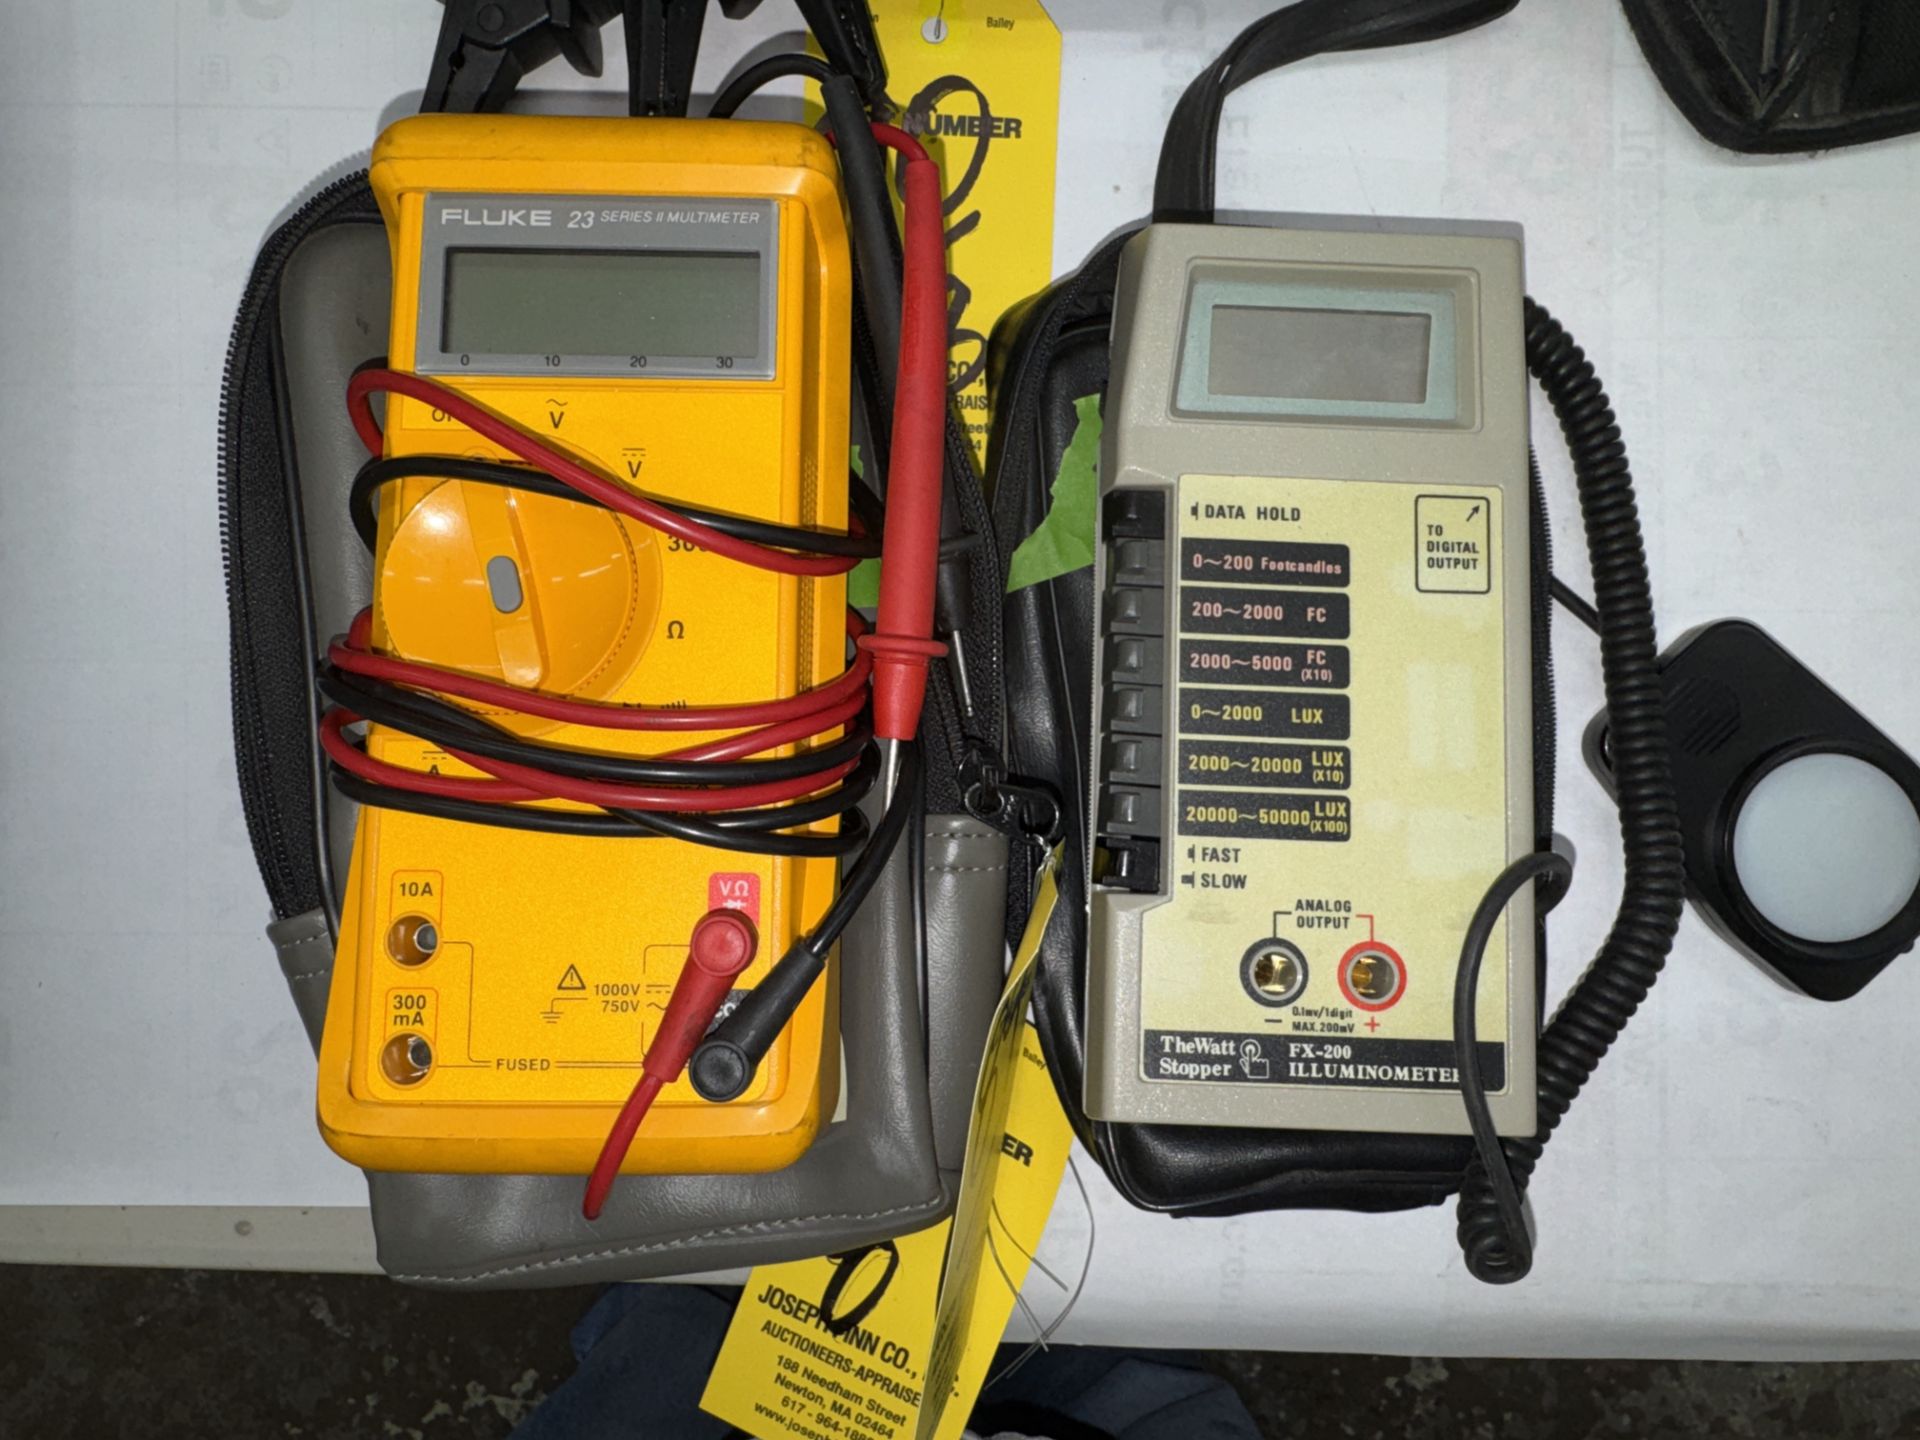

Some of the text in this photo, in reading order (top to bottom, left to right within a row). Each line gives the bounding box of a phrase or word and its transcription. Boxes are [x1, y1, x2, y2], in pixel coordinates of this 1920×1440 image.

[986, 16, 1015, 31] Bailey
[441, 208, 552, 227] FLUKE
[567, 211, 595, 229] 23
[600, 210, 652, 224] SERIES
[666, 211, 760, 225] MULTIMETER
[460, 355, 734, 369] 0 10 20 30
[550, 411, 564, 430] V
[627, 460, 642, 479] V
[1205, 504, 1301, 522] DATA HOLD
[1427, 524, 1443, 537] TO
[668, 534, 708, 552] 30
[1426, 541, 1480, 555] DIGITAL
[1261, 556, 1342, 575] Footcandles
[1427, 557, 1479, 571] OUTPUT
[1307, 607, 1327, 623] FC
[1307, 650, 1326, 666] FC
[1291, 708, 1323, 724] LUX
[1312, 750, 1344, 767] LUX
[1315, 801, 1347, 818] LUX
[1201, 847, 1241, 863] FAST
[399, 881, 434, 897] 10A
[1201, 874, 1247, 889] SLOW
[1295, 899, 1352, 913] ANALOG
[1296, 916, 1350, 930] OUTPUT
[594, 983, 640, 997] 1000V
[393, 994, 426, 1010] 300
[601, 1000, 640, 1013] 750V
[393, 1011, 425, 1027] mA
[1160, 1036, 1236, 1056] TheWatt
[1289, 1043, 1351, 1060] FX-200
[496, 1057, 551, 1071] FUSED
[1159, 1058, 1232, 1079] Stopper
[761, 1319, 921, 1407] AUCTIONEERS-APPRAISE
[776, 1354, 906, 1427] 188 Needham Street
[774, 1373, 895, 1439] Newton, MA 02464
[781, 1395, 806, 1414] 617
